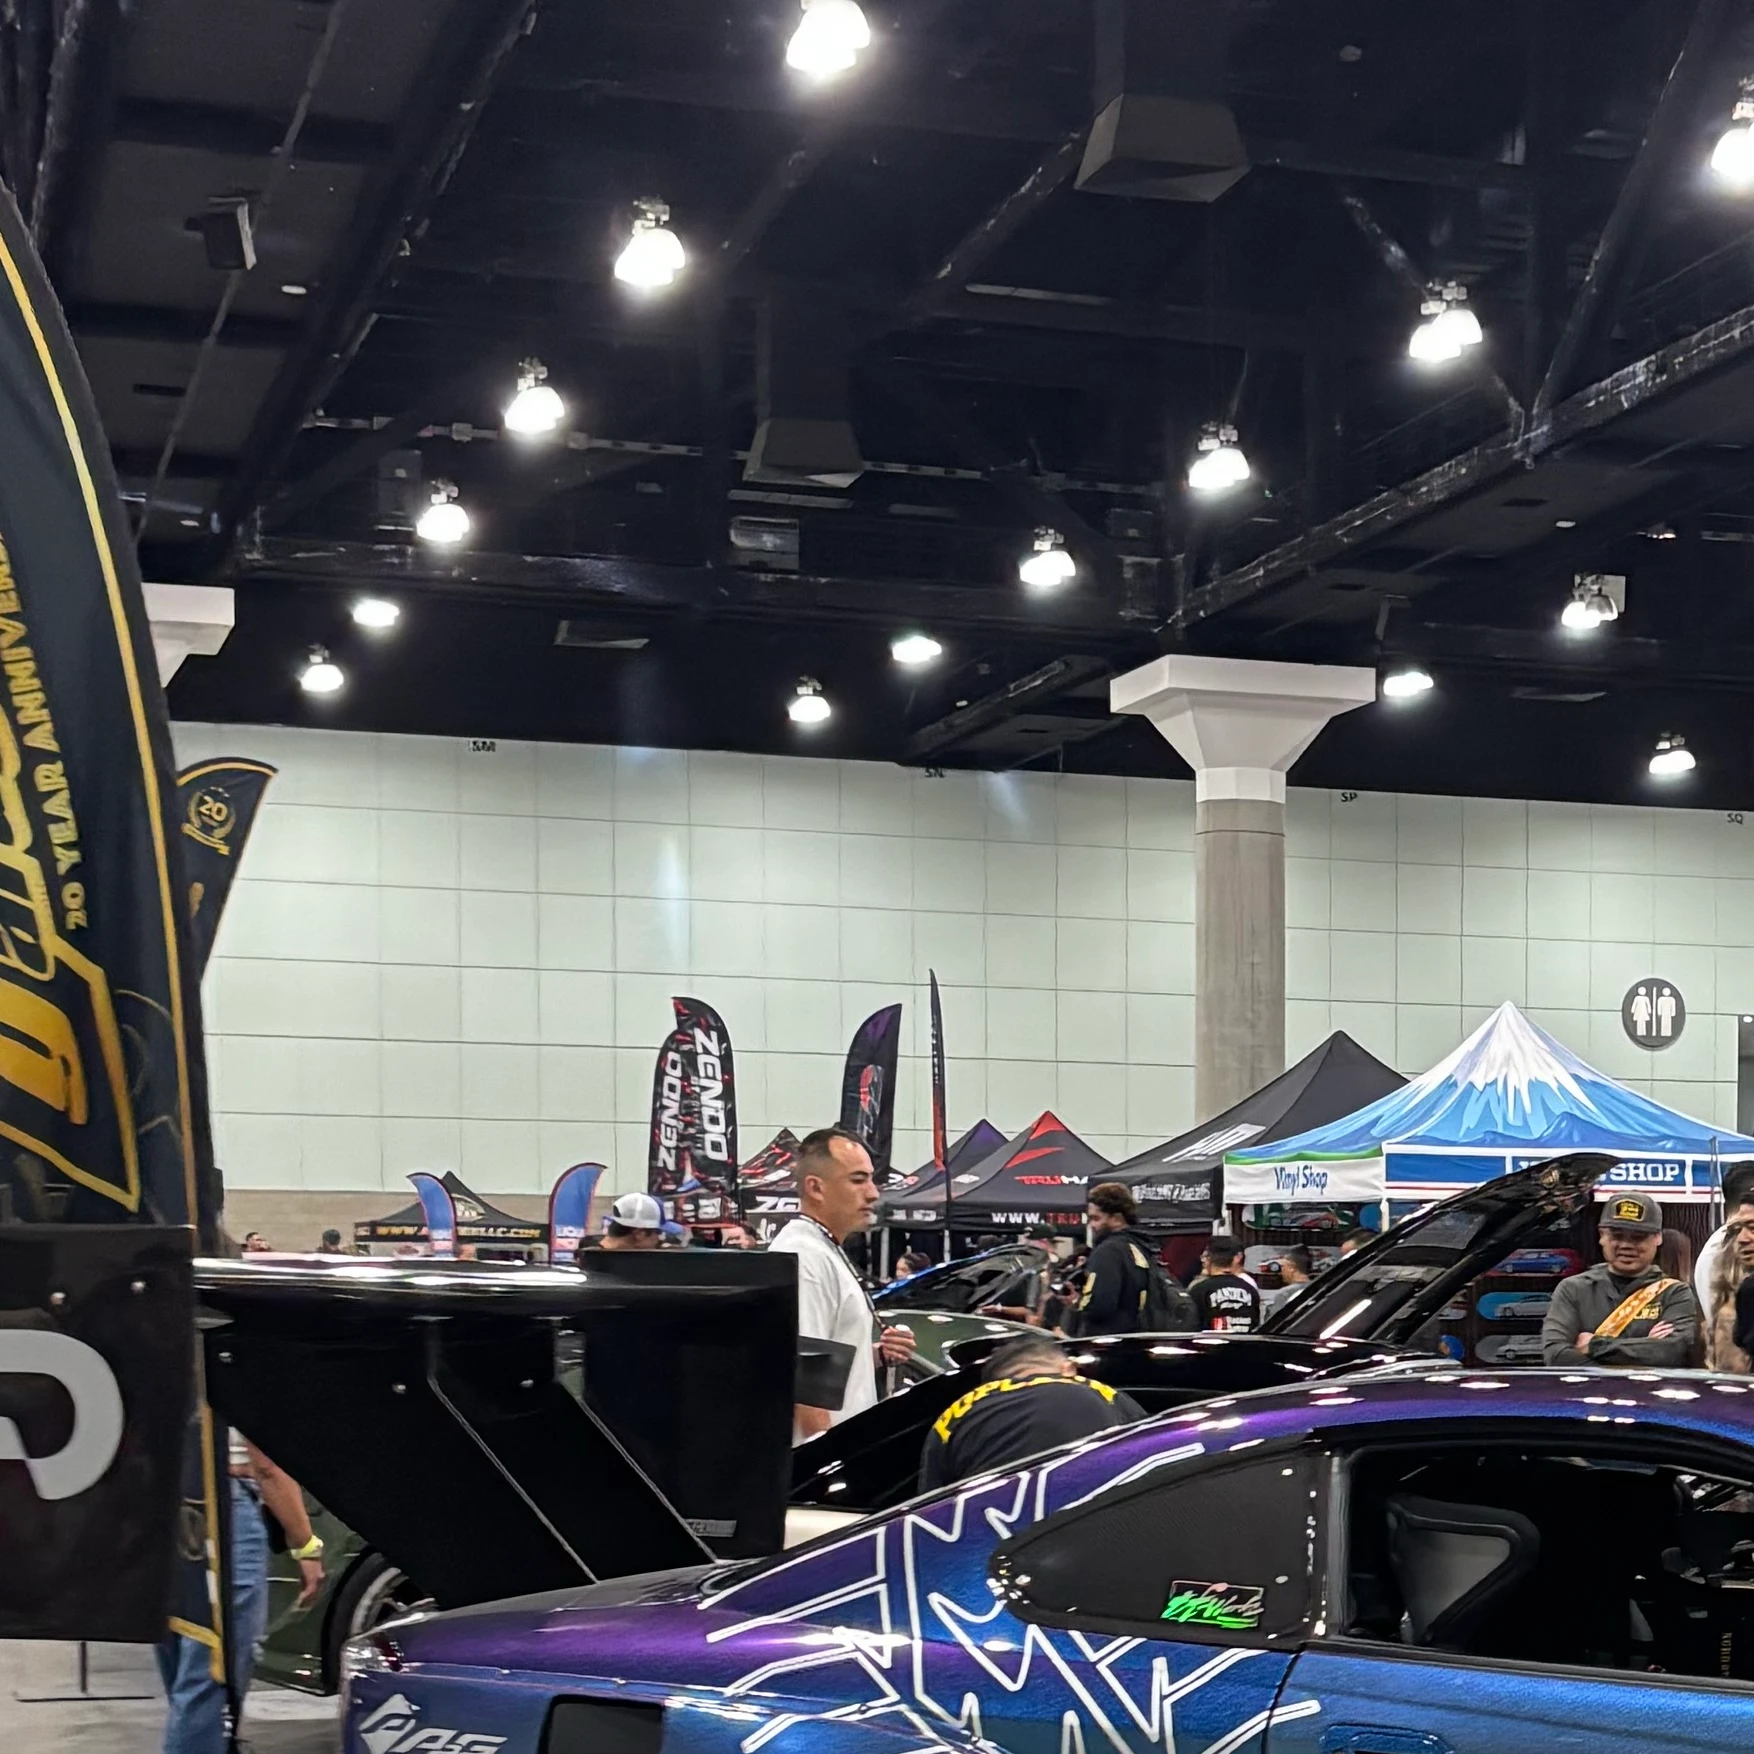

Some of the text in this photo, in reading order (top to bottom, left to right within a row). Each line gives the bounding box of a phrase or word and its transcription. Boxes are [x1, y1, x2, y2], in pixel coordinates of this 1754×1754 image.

[0, 531, 60, 753] ANNIVE
[34, 760, 82, 876] YEAR
[199, 795, 228, 821] 20
[61, 881, 88, 930] 20
[657, 1051, 683, 1172] ZENDO
[693, 1027, 729, 1161] ZENDO
[1609, 1163, 1680, 1183] SHOP
